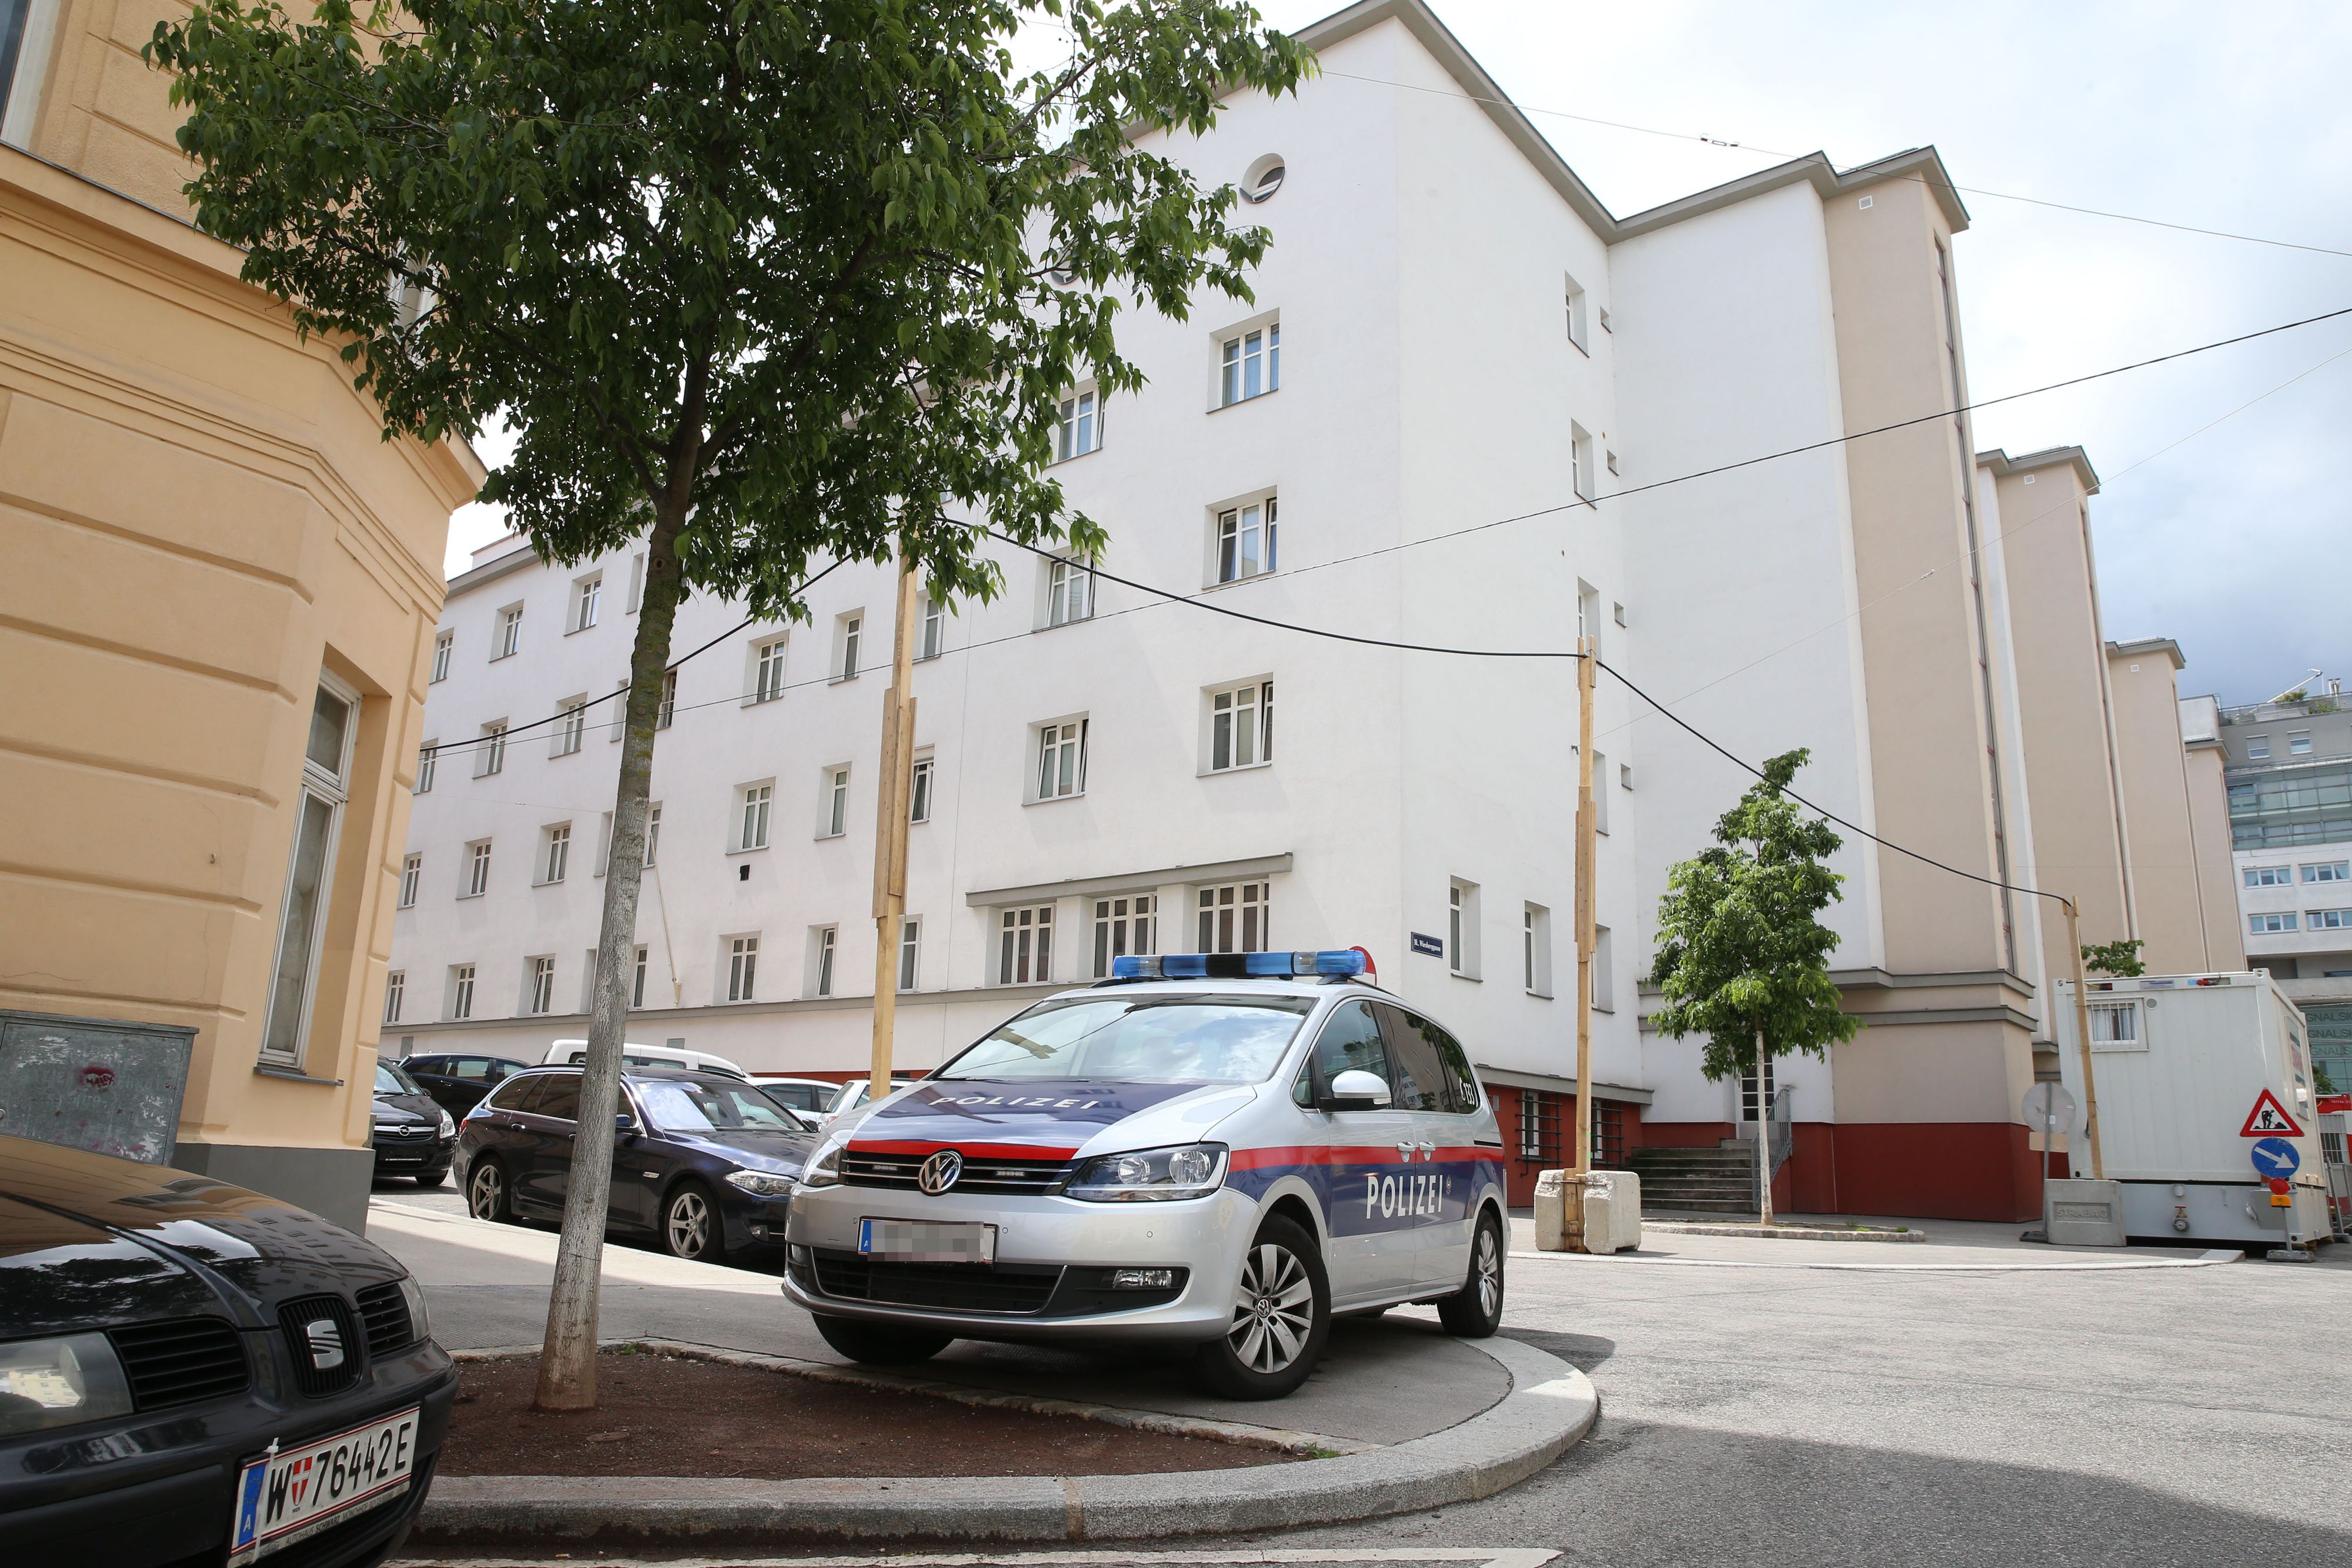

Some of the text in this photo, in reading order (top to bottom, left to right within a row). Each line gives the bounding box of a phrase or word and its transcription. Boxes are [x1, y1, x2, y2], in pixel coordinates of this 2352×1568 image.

[928, 1096, 1100, 1109] POLIZEI
[1463, 1082, 1475, 1105] 133
[1366, 1175, 1443, 1219] POLIZEI
[2056, 1208, 2108, 1218] STRABAG
[266, 1462, 292, 1524] W
[243, 1514, 252, 1533] A
[286, 1528, 315, 1545] AUTOHAUS
[316, 1515, 340, 1532] SCHWARZ
